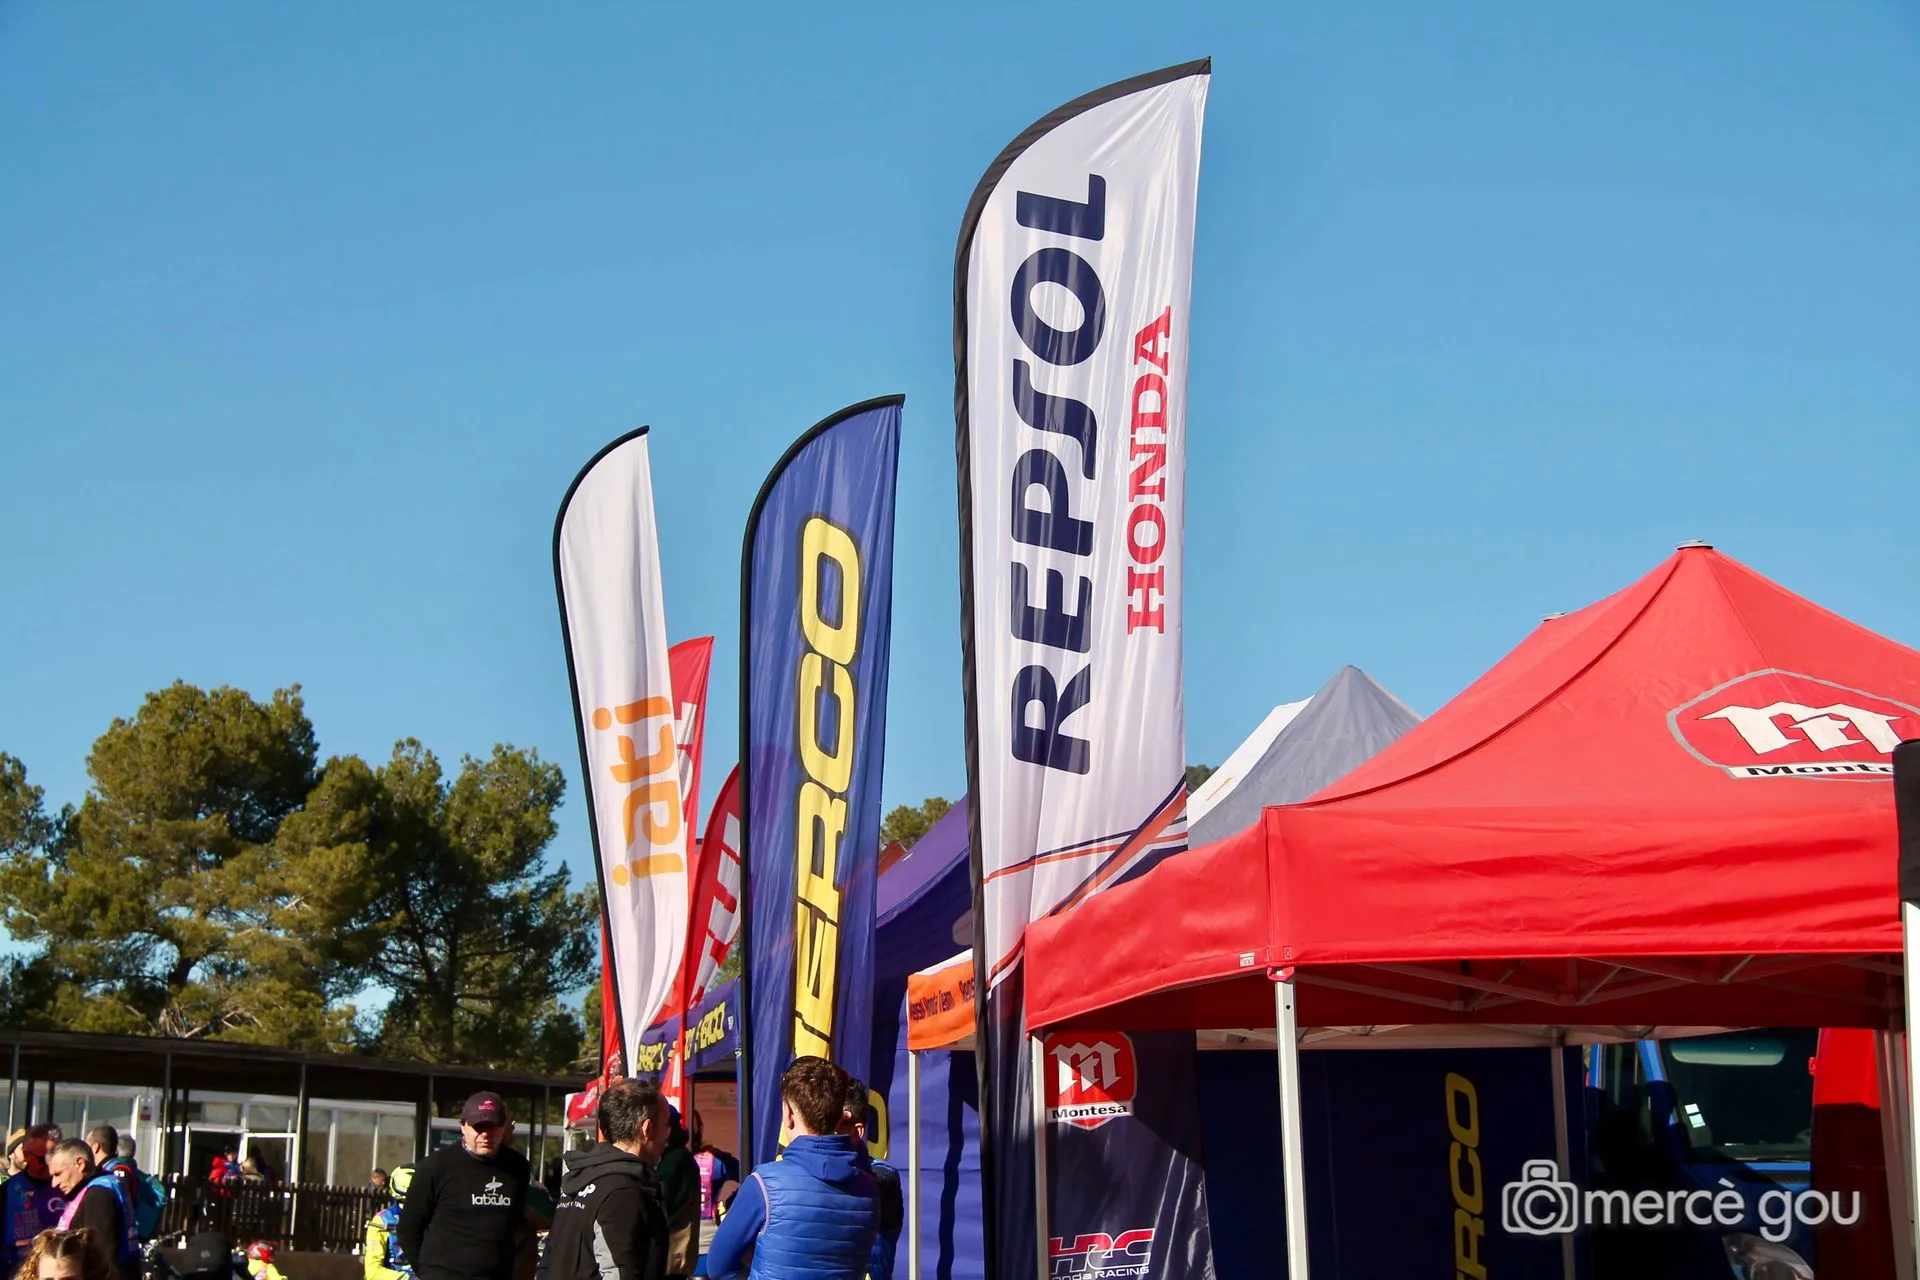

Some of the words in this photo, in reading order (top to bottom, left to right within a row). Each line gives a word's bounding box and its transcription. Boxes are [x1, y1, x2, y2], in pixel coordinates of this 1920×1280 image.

[1010, 173, 1106, 776] REPSOL
[1126, 305, 1171, 636] HONDA
[794, 518, 860, 1060] ERCO
[1746, 764, 1894, 777] Mont
[1051, 1105, 1128, 1119] Montesa
[1094, 1265, 1150, 1280] RACING
